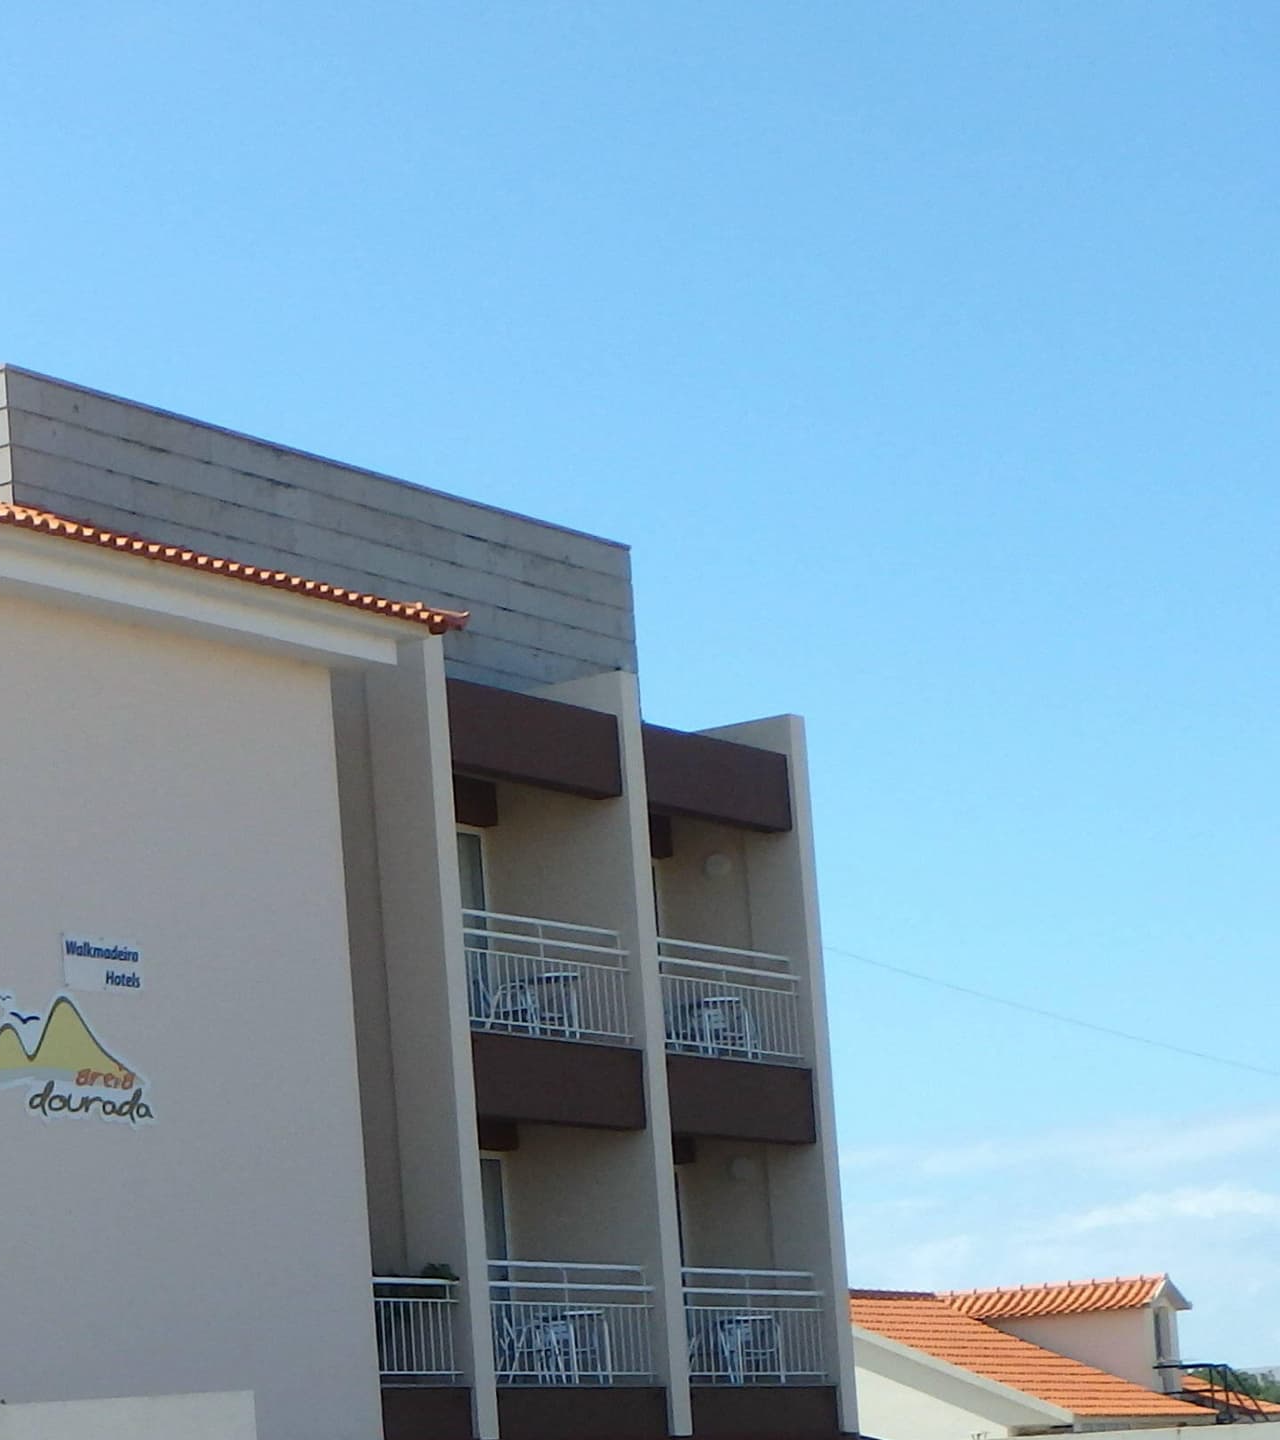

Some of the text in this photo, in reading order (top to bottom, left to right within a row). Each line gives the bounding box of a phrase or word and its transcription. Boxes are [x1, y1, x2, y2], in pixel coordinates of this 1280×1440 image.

[65, 940, 139, 963] Walkmadeira
[105, 970, 141, 988] Hotels
[74, 1063, 135, 1090] areia
[28, 1080, 154, 1122] dourada
